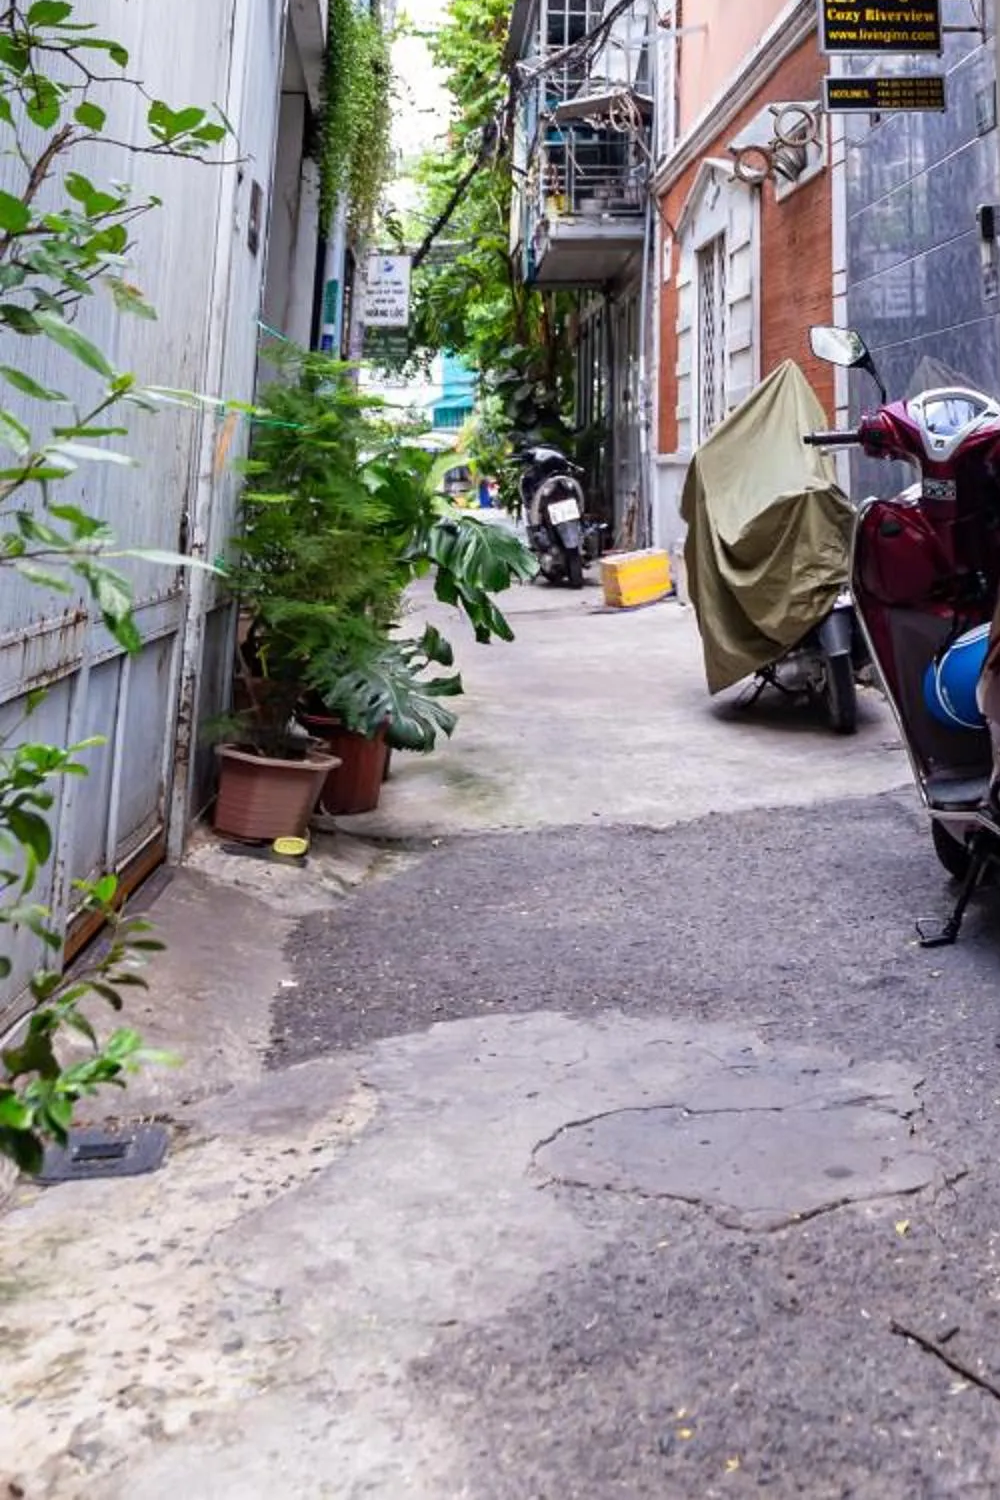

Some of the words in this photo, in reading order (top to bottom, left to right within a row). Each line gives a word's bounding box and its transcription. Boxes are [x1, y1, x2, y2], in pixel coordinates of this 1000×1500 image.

[827, 8, 861, 23] Cozy
[865, 8, 935, 22] Riverview
[828, 29, 935, 42] www.livinginn.com
